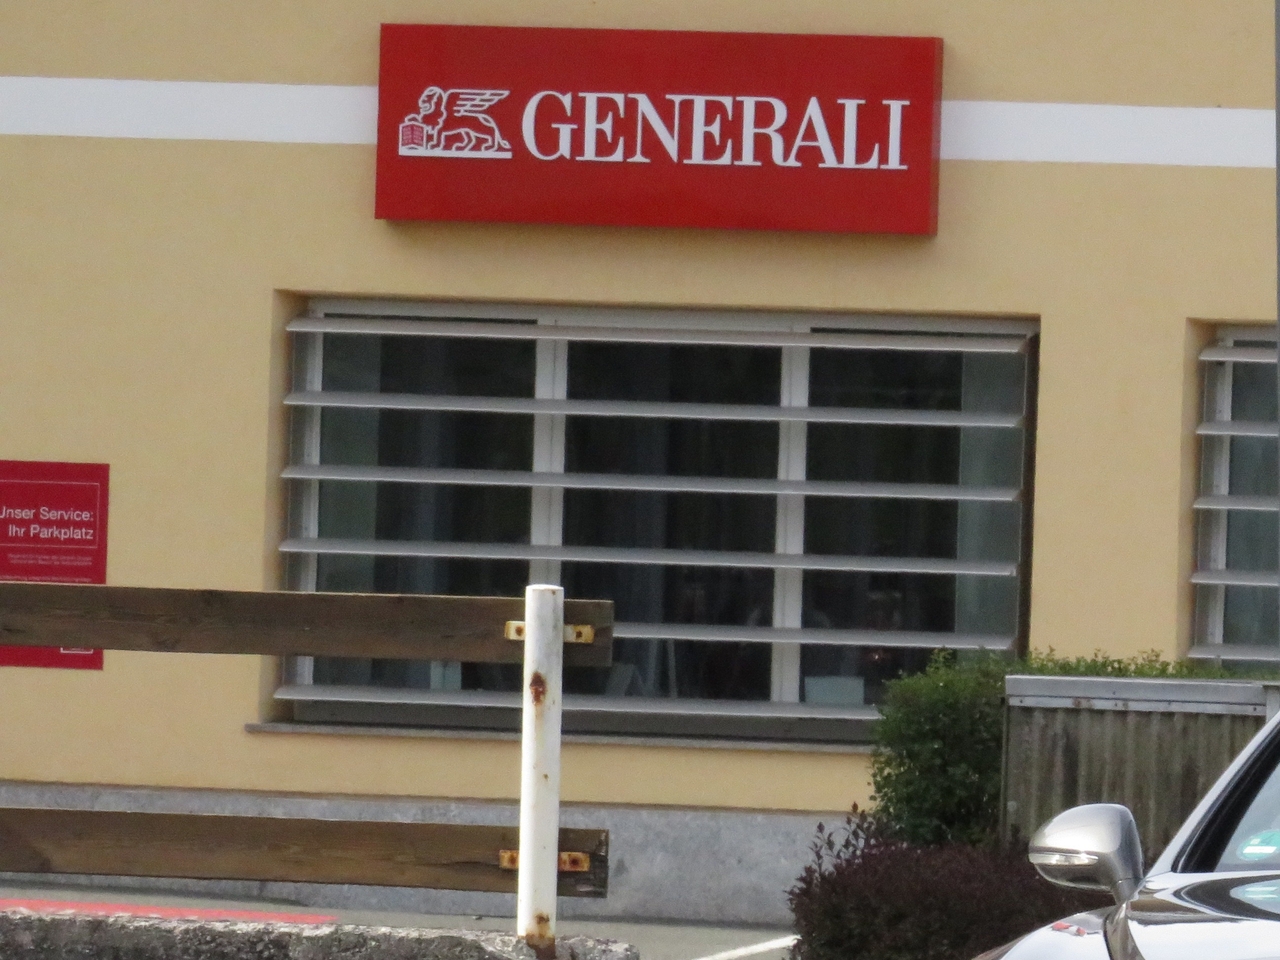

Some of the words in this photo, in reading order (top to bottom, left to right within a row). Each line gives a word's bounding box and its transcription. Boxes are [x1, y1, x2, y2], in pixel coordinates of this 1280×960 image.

[521, 90, 911, 170] GENERALI
[40, 506, 94, 521] Service:
[8, 524, 26, 537] Ihr
[30, 524, 94, 541] Parkplatz
